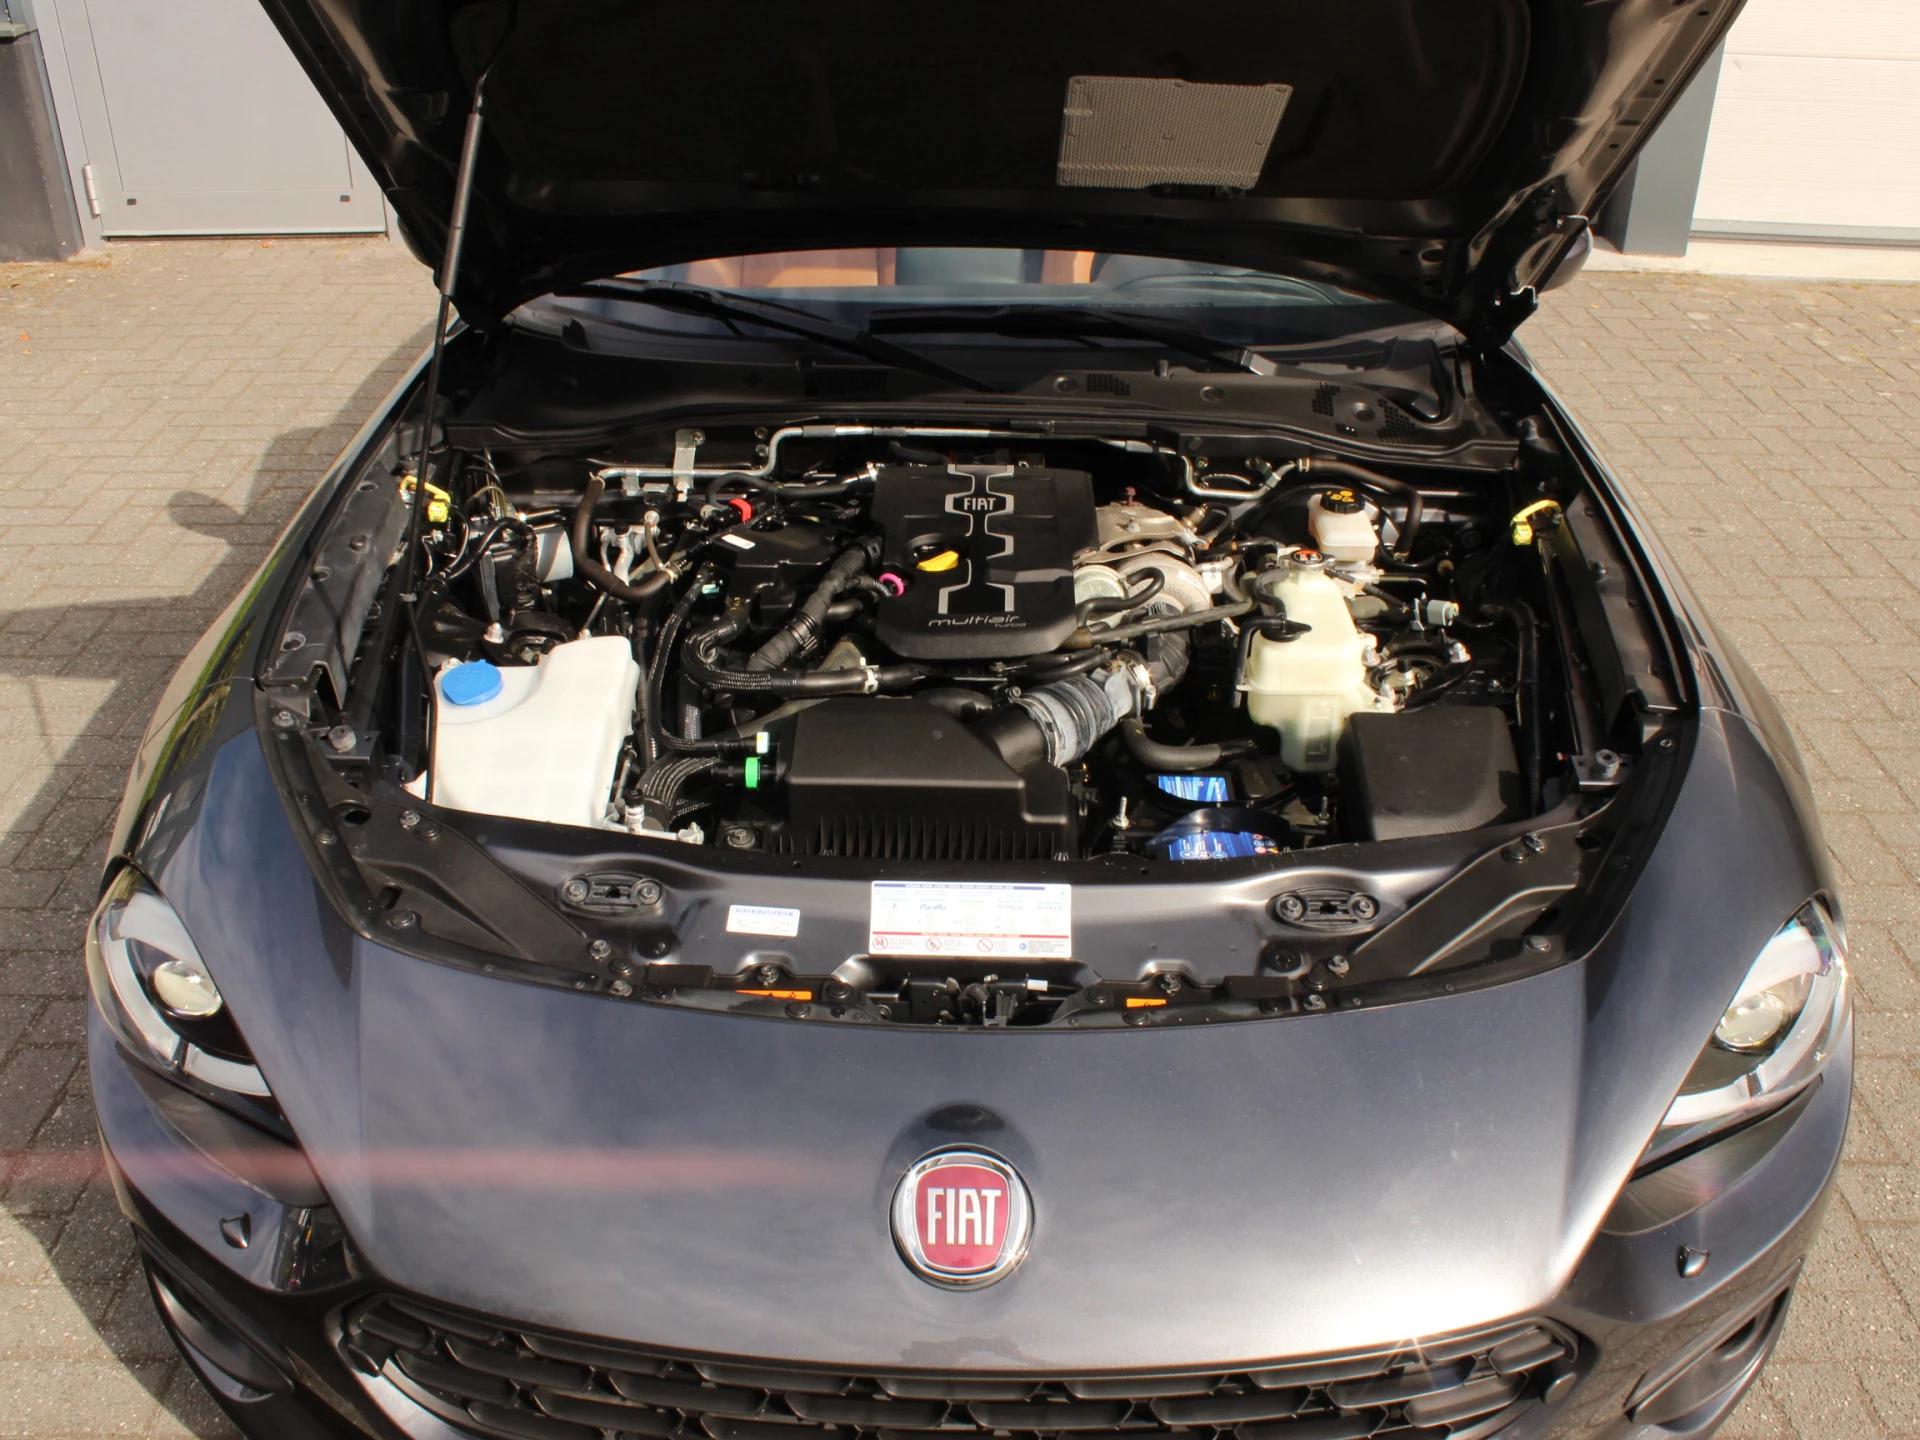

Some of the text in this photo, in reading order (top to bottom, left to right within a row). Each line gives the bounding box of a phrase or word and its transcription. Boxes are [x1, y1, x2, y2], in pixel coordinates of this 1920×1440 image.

[963, 497, 997, 511] FIAT
[928, 614, 1020, 627] multiair
[926, 1187, 1002, 1246] FIAT
